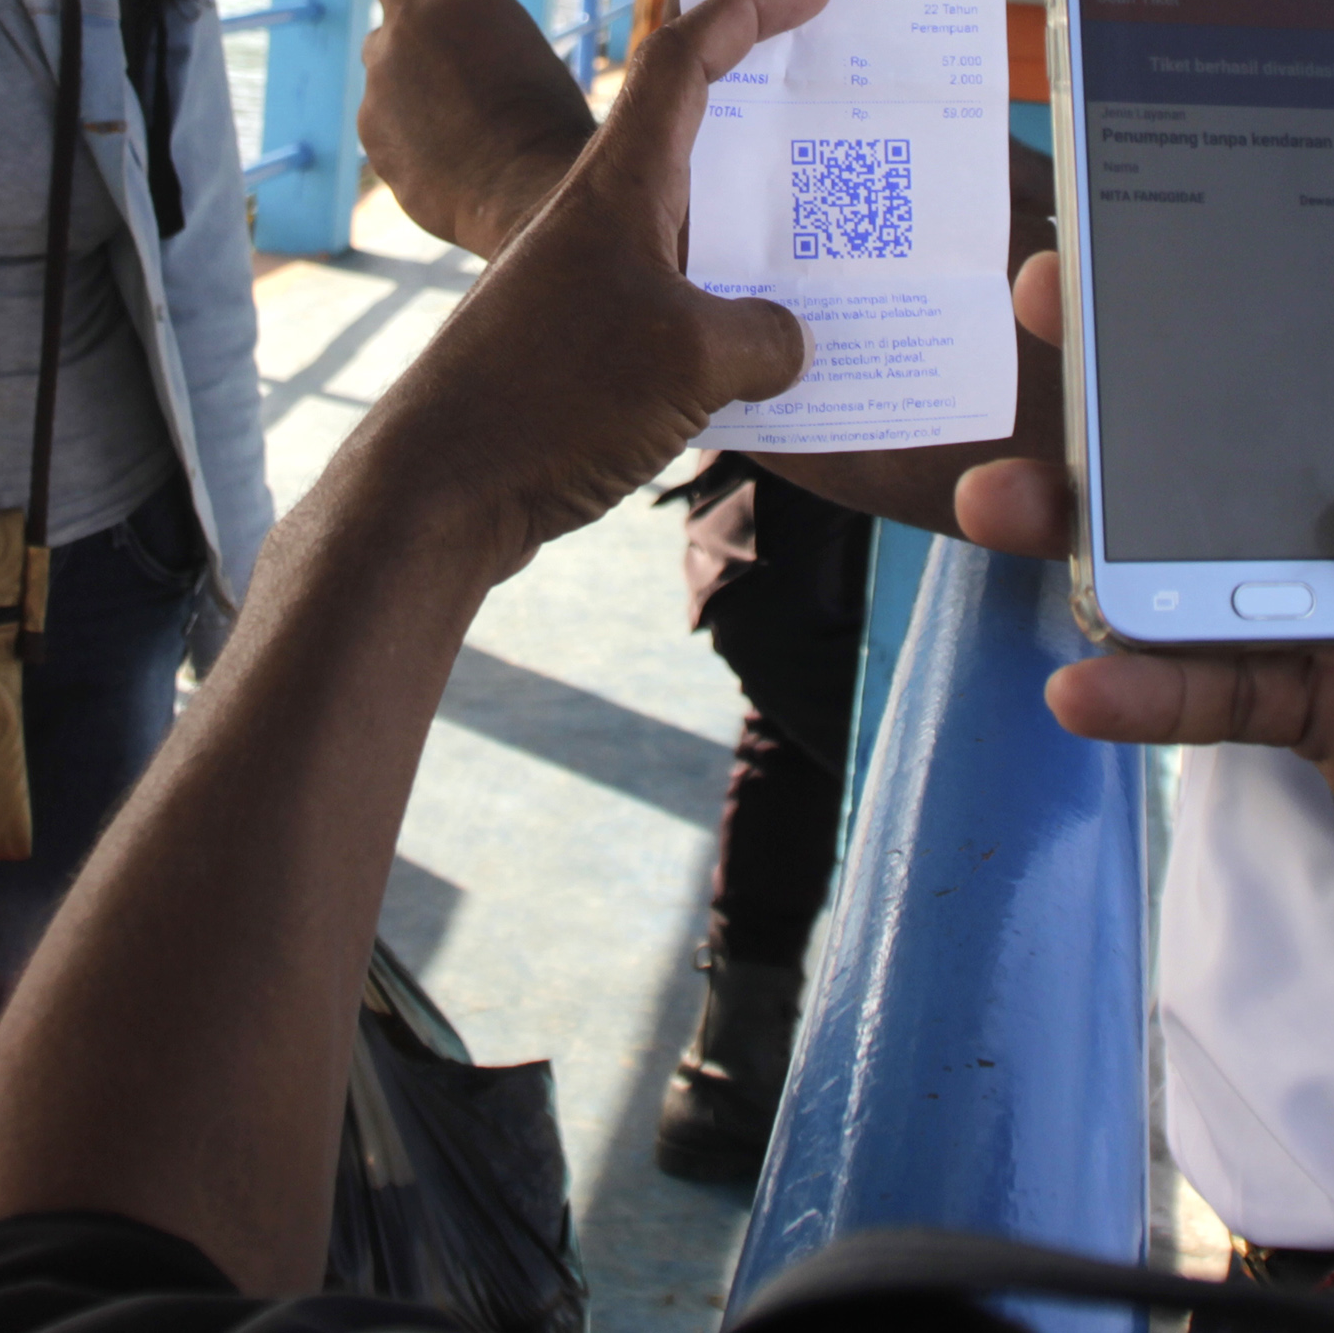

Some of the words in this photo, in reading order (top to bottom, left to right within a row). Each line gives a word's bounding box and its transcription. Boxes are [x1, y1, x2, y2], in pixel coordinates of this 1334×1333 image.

[924, 4, 938, 15] 22
[943, 3, 978, 15] Tahun
[911, 22, 979, 35] Perempuan
[850, 56, 871, 69] Rp.
[942, 56, 982, 67] 57.000
[1150, 56, 1191, 72] Tiket
[1194, 57, 1259, 76] berhasil
[851, 74, 872, 87] Rp.
[950, 74, 983, 85] 2.000
[708, 105, 743, 118] TOTAL
[943, 107, 983, 119] 59.000
[1136, 109, 1186, 123] Layanan
[1102, 128, 1197, 148] Penumpang
[1203, 131, 1248, 150] tanpa
[1251, 133, 1333, 150] kendaraan
[1103, 161, 1139, 174] Nama
[1101, 190, 1131, 203] NITA
[1133, 191, 1205, 204] FANGGIDAE
[704, 281, 777, 296] Keterangan:
[803, 296, 844, 309] jangan
[847, 294, 888, 307] sampai
[843, 310, 877, 320] waktu
[880, 307, 942, 320] pelabuhan
[826, 341, 861, 351] check
[864, 340, 876, 350] in
[879, 338, 890, 349] di
[892, 335, 955, 351] pelabuhan
[831, 354, 881, 366] sebelum
[828, 369, 883, 381] termasuk
[745, 404, 764, 416] PT.
[768, 402, 803, 414] ASDP
[808, 401, 864, 413] Indonesia
[868, 399, 898, 411] Ferry
[902, 396, 956, 411] (Persero)
